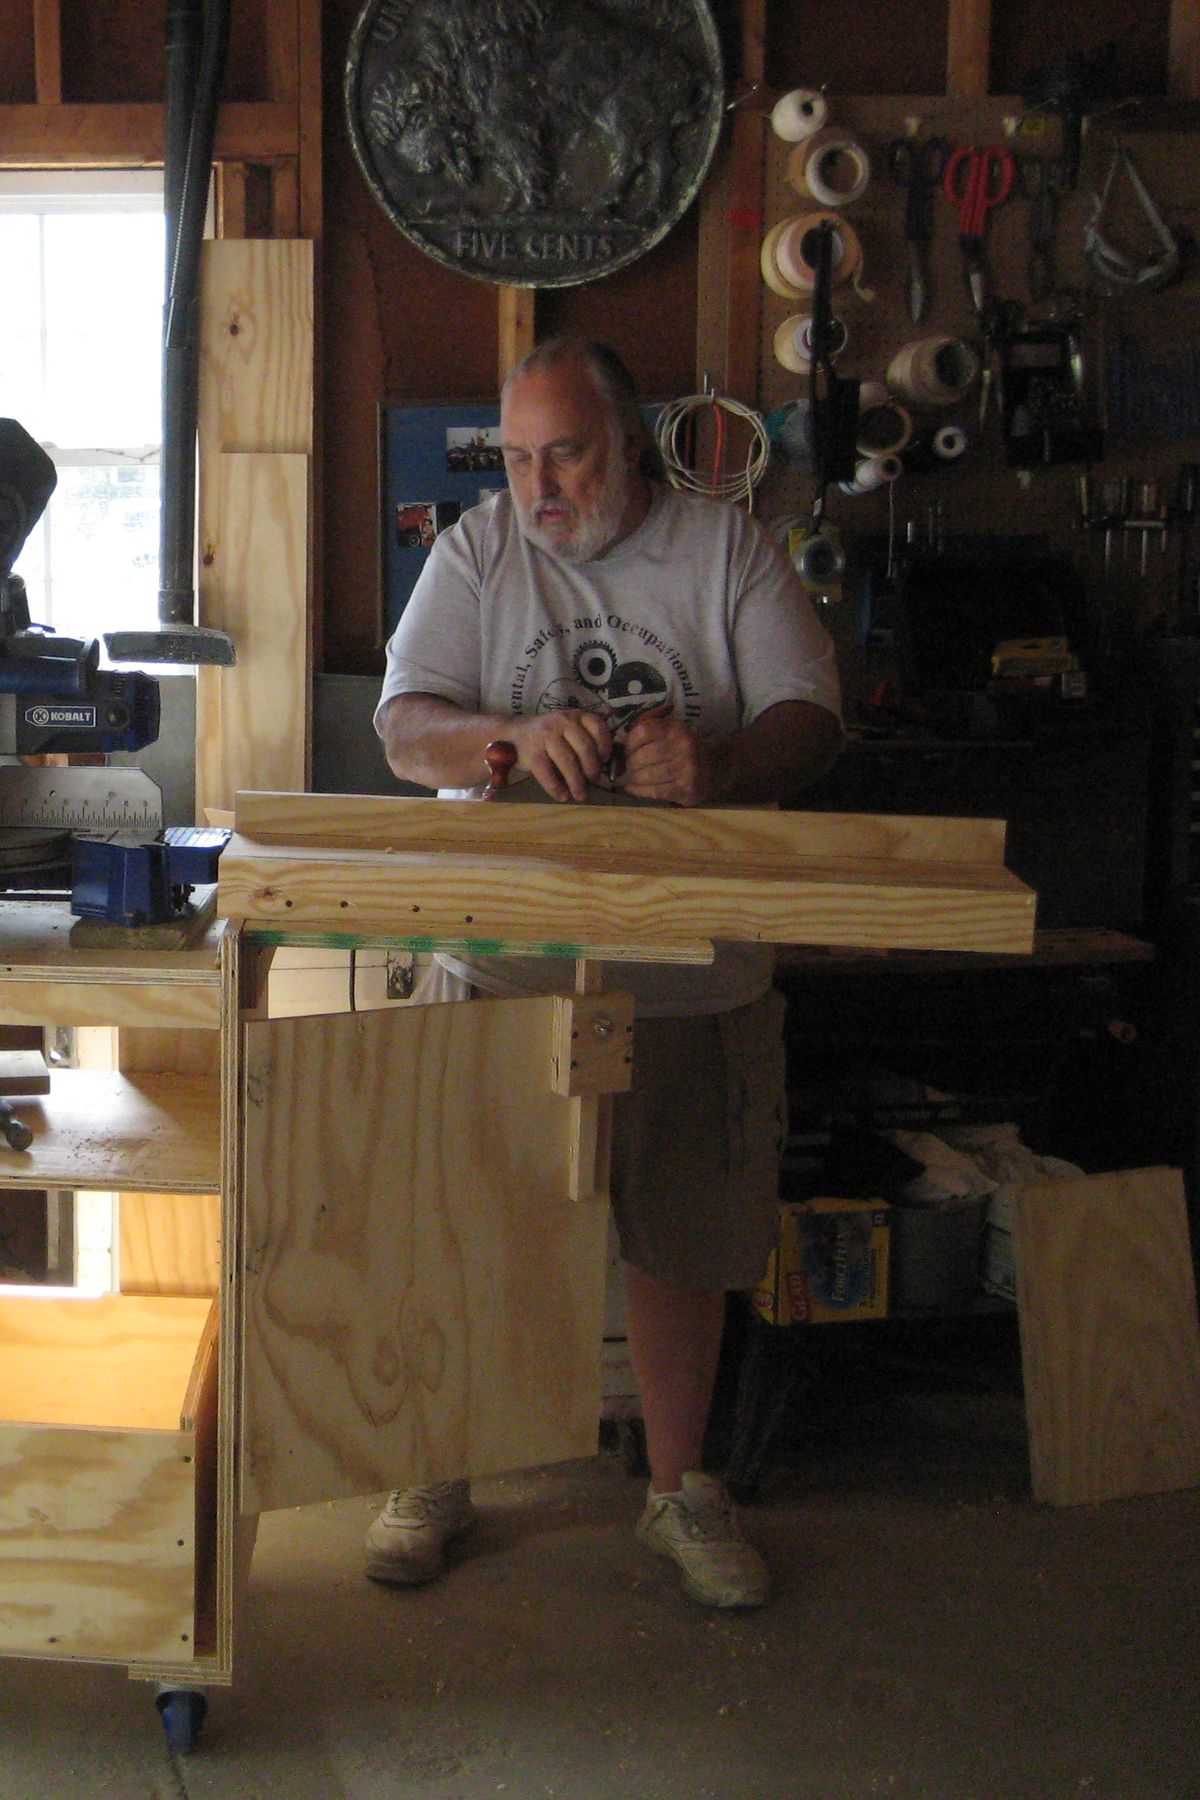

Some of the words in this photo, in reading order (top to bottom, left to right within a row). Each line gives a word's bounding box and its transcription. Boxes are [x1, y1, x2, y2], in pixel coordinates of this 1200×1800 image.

[456, 230, 517, 260] FIVE
[523, 233, 613, 262] CENTS
[572, 613, 602, 630] and
[50, 711, 92, 722] KOBALT
